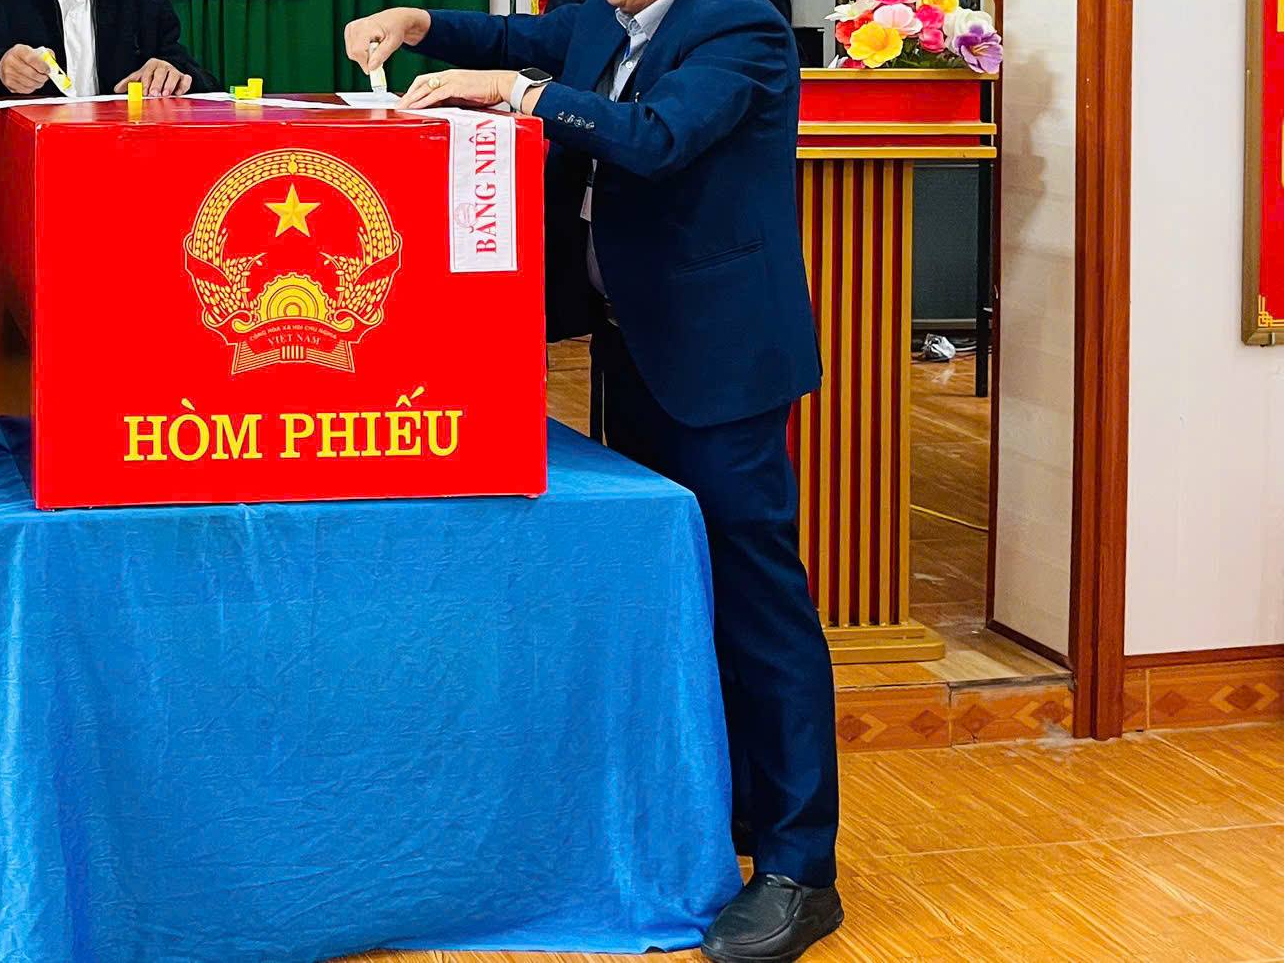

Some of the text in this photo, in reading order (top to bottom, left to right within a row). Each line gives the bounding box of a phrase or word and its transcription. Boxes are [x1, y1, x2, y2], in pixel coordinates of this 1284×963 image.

[468, 181, 497, 254] BĂNG
[123, 386, 464, 462] HÒM PHIẾU
